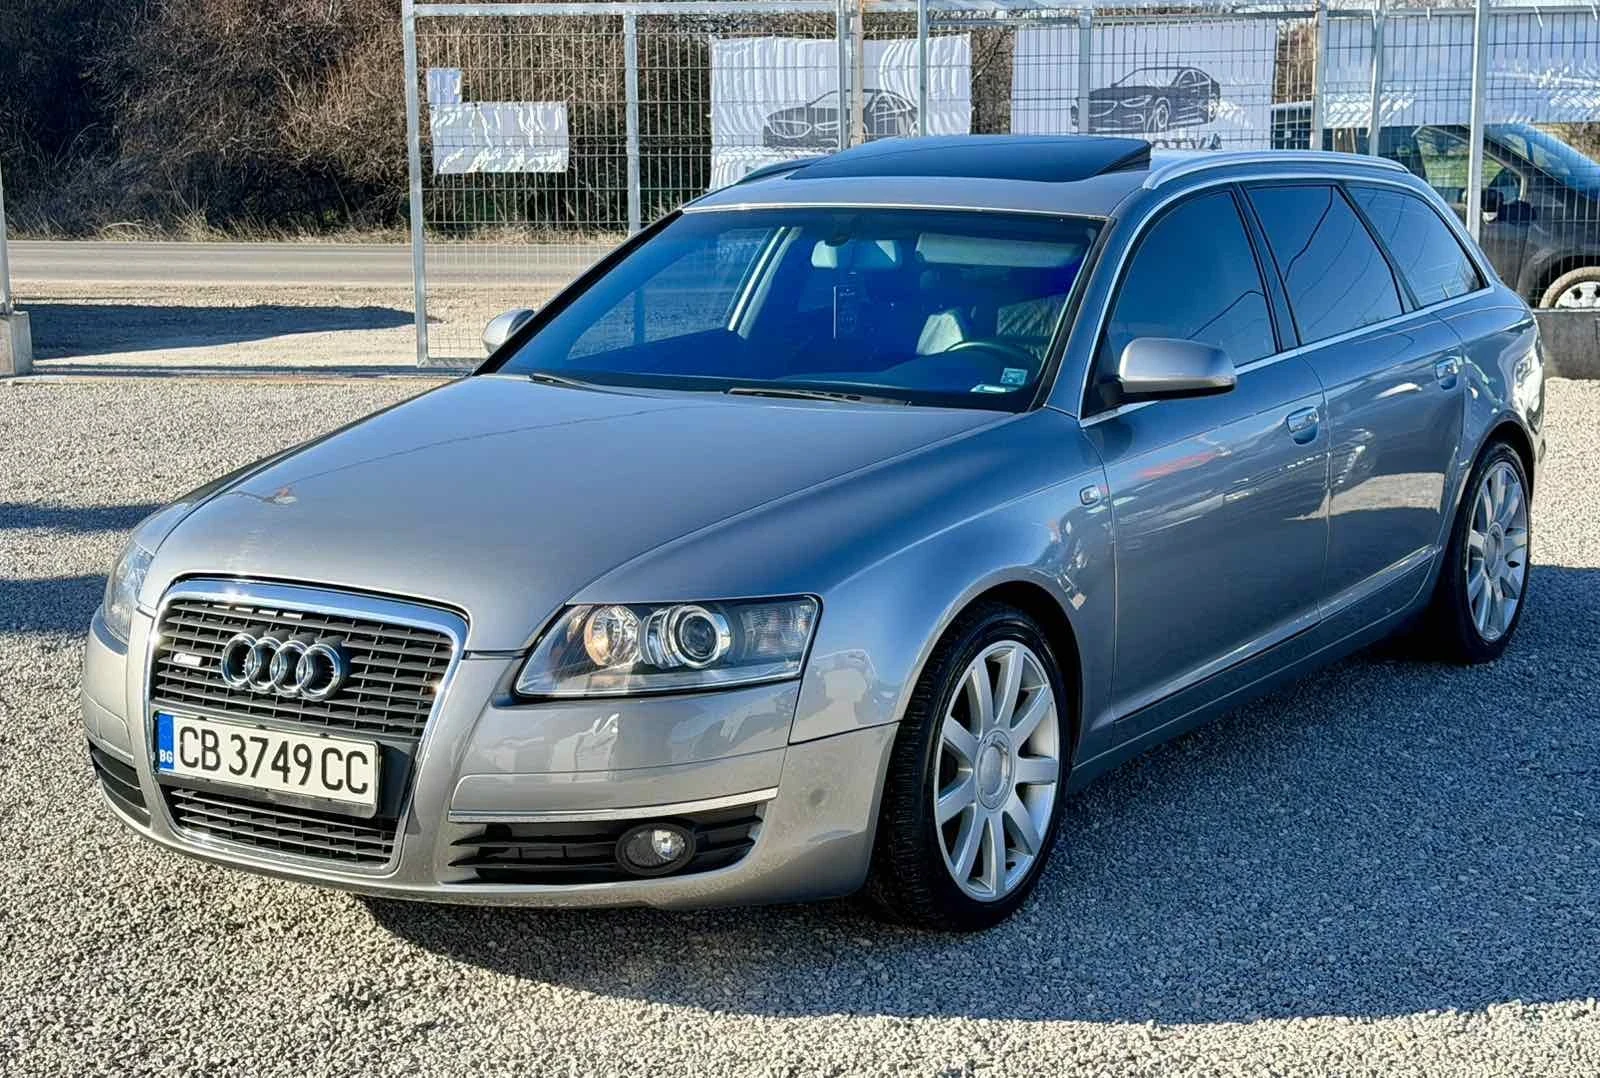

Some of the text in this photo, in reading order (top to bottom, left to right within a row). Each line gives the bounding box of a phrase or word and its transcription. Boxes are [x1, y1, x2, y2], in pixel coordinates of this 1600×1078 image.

[159, 750, 174, 764] BG
[179, 726, 369, 794] CB 3749 CC
